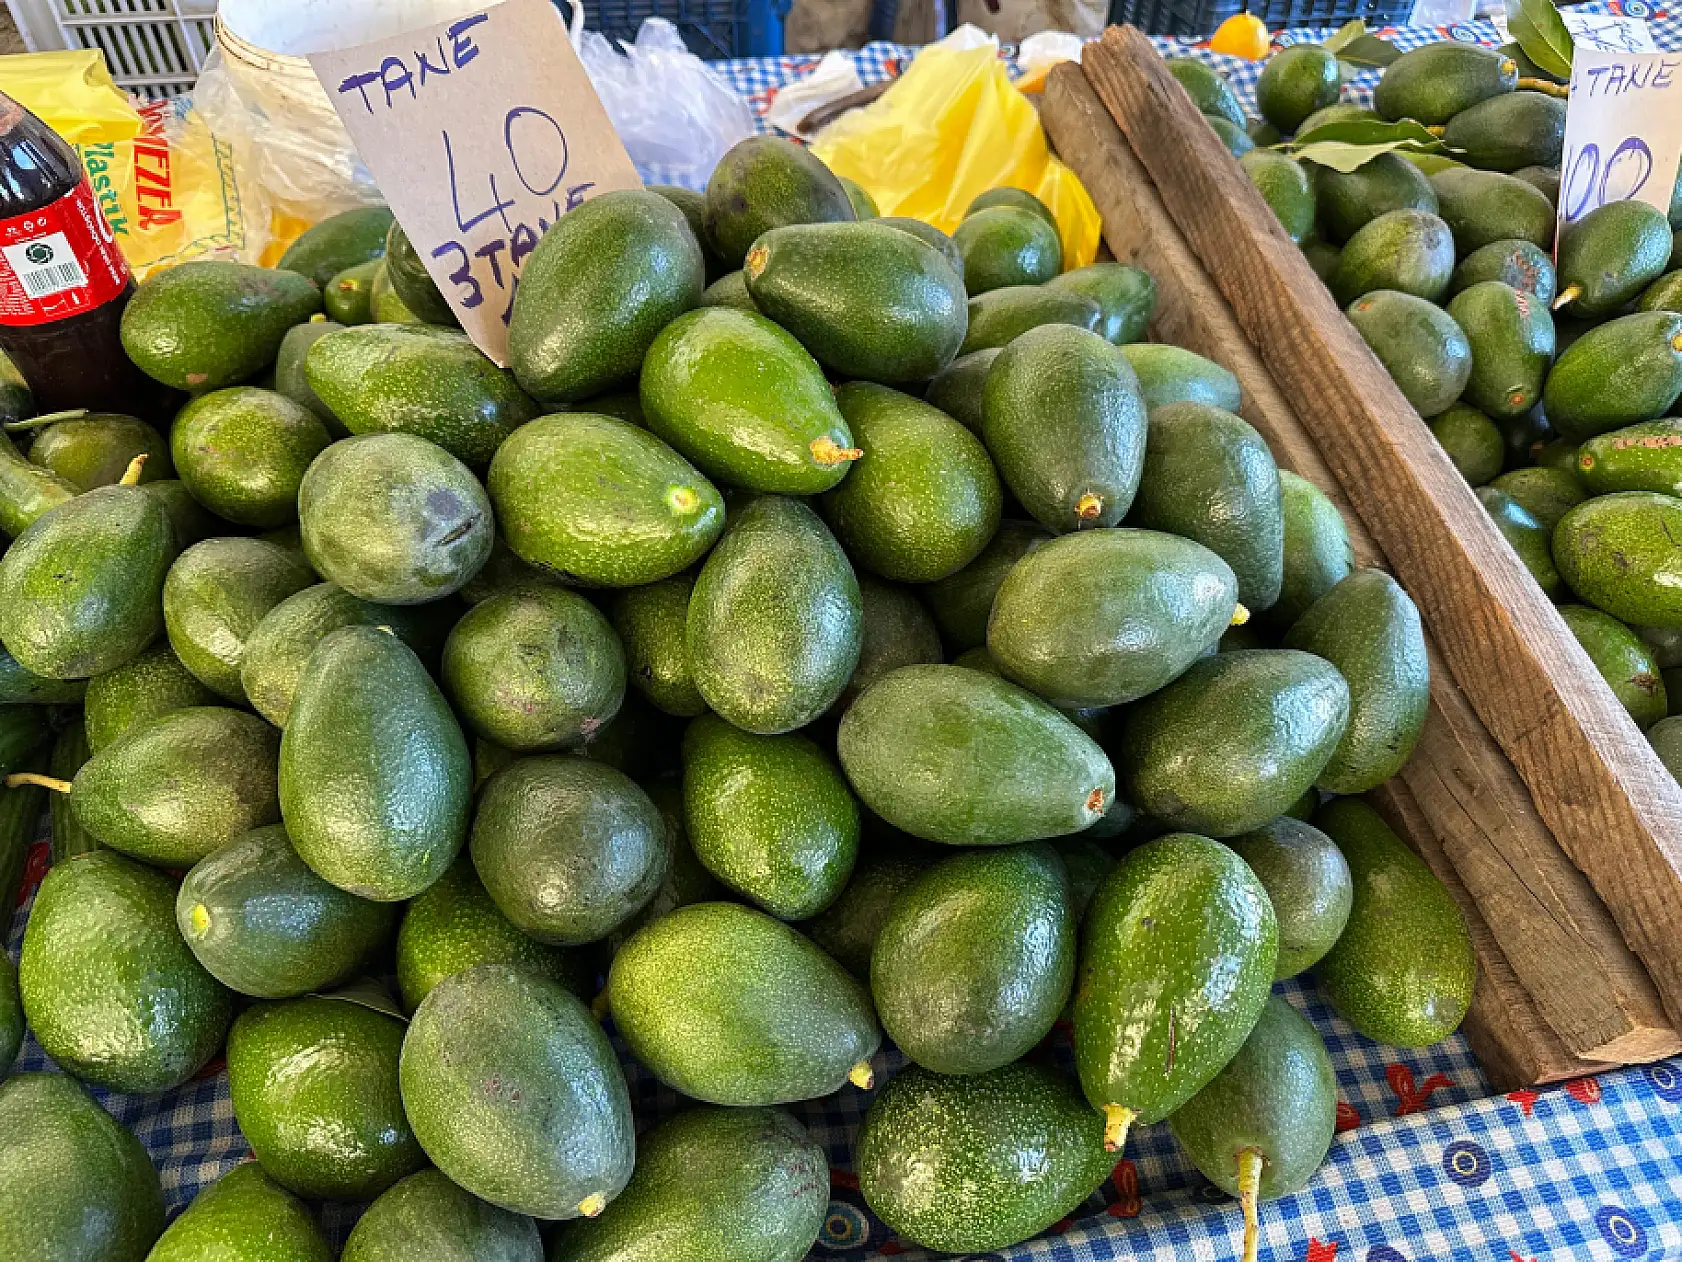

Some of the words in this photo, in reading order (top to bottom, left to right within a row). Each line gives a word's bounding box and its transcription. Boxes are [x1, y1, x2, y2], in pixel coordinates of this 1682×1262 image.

[339, 13, 488, 114] TANE
[1588, 58, 1681, 97] TANE
[442, 107, 567, 233] 40
